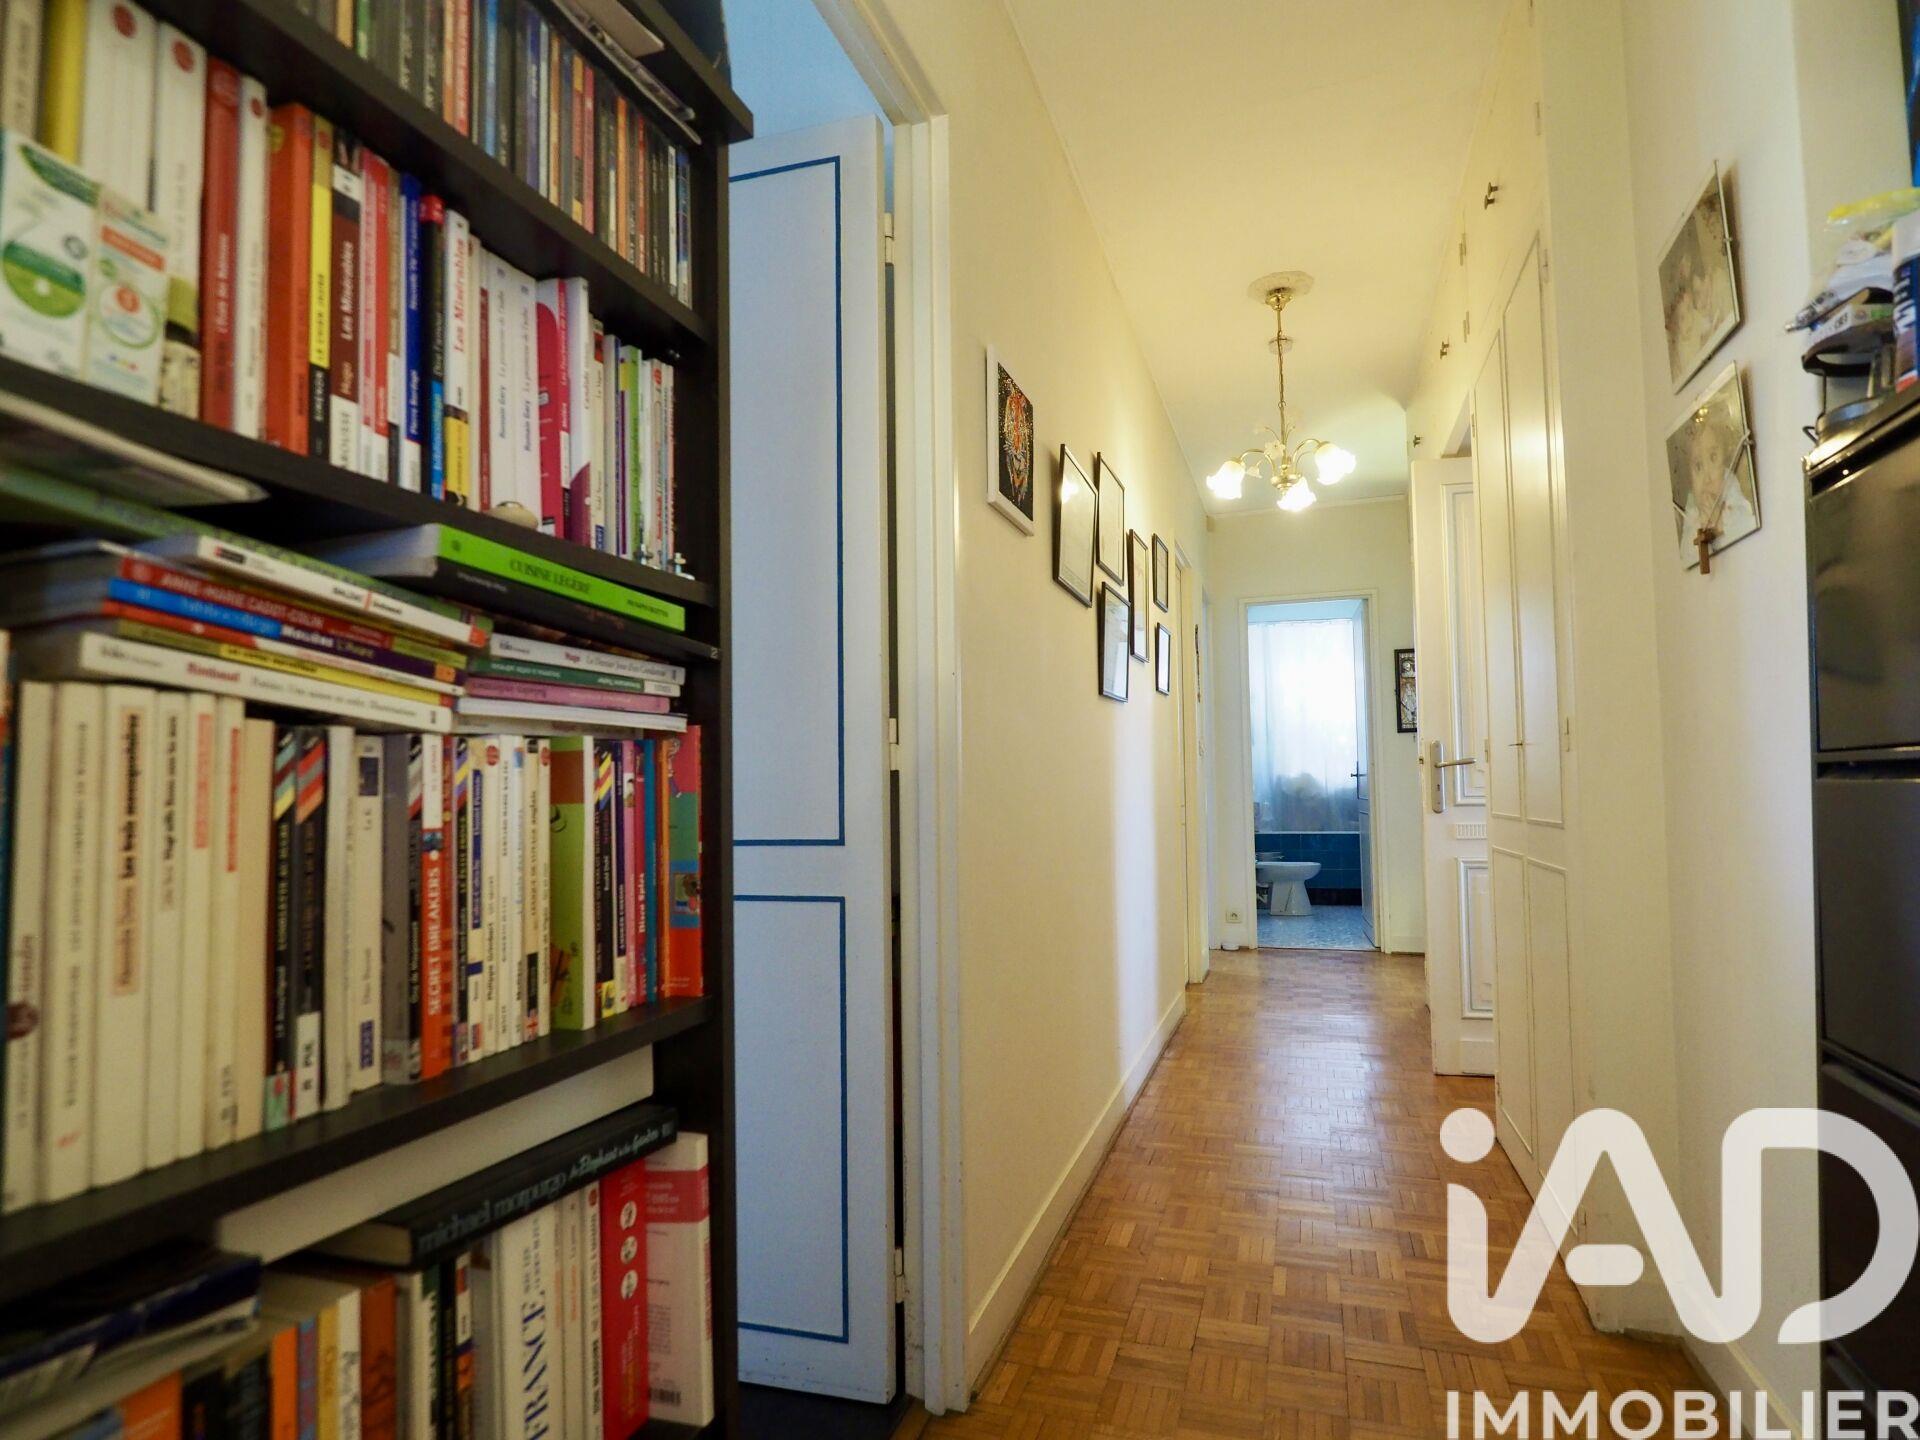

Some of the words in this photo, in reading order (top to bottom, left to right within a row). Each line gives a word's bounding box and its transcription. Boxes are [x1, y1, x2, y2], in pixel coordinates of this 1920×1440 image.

[339, 240, 355, 315] Misérables
[450, 238, 466, 321] Misérables
[339, 315, 354, 341] Les
[450, 326, 466, 353] Les
[339, 360, 355, 395] Hugo
[496, 384, 509, 404] Gary
[312, 369, 326, 422] SIMENON
[520, 399, 534, 420] Gary
[497, 405, 508, 439] Romain
[521, 420, 533, 452] Romain
[509, 559, 553, 585] CUISINE
[121, 714, 141, 817] mousquetaires
[472, 807, 482, 836] Daniel
[527, 790, 539, 825] anglais
[120, 821, 136, 853] trois
[118, 856, 136, 879] Les
[427, 867, 442, 952] BREAKERS
[427, 957, 442, 1017] SECRET
[486, 964, 496, 1001] Philippe
[301, 1043, 312, 1069] PUL
[418, 1200, 491, 1252] michael
